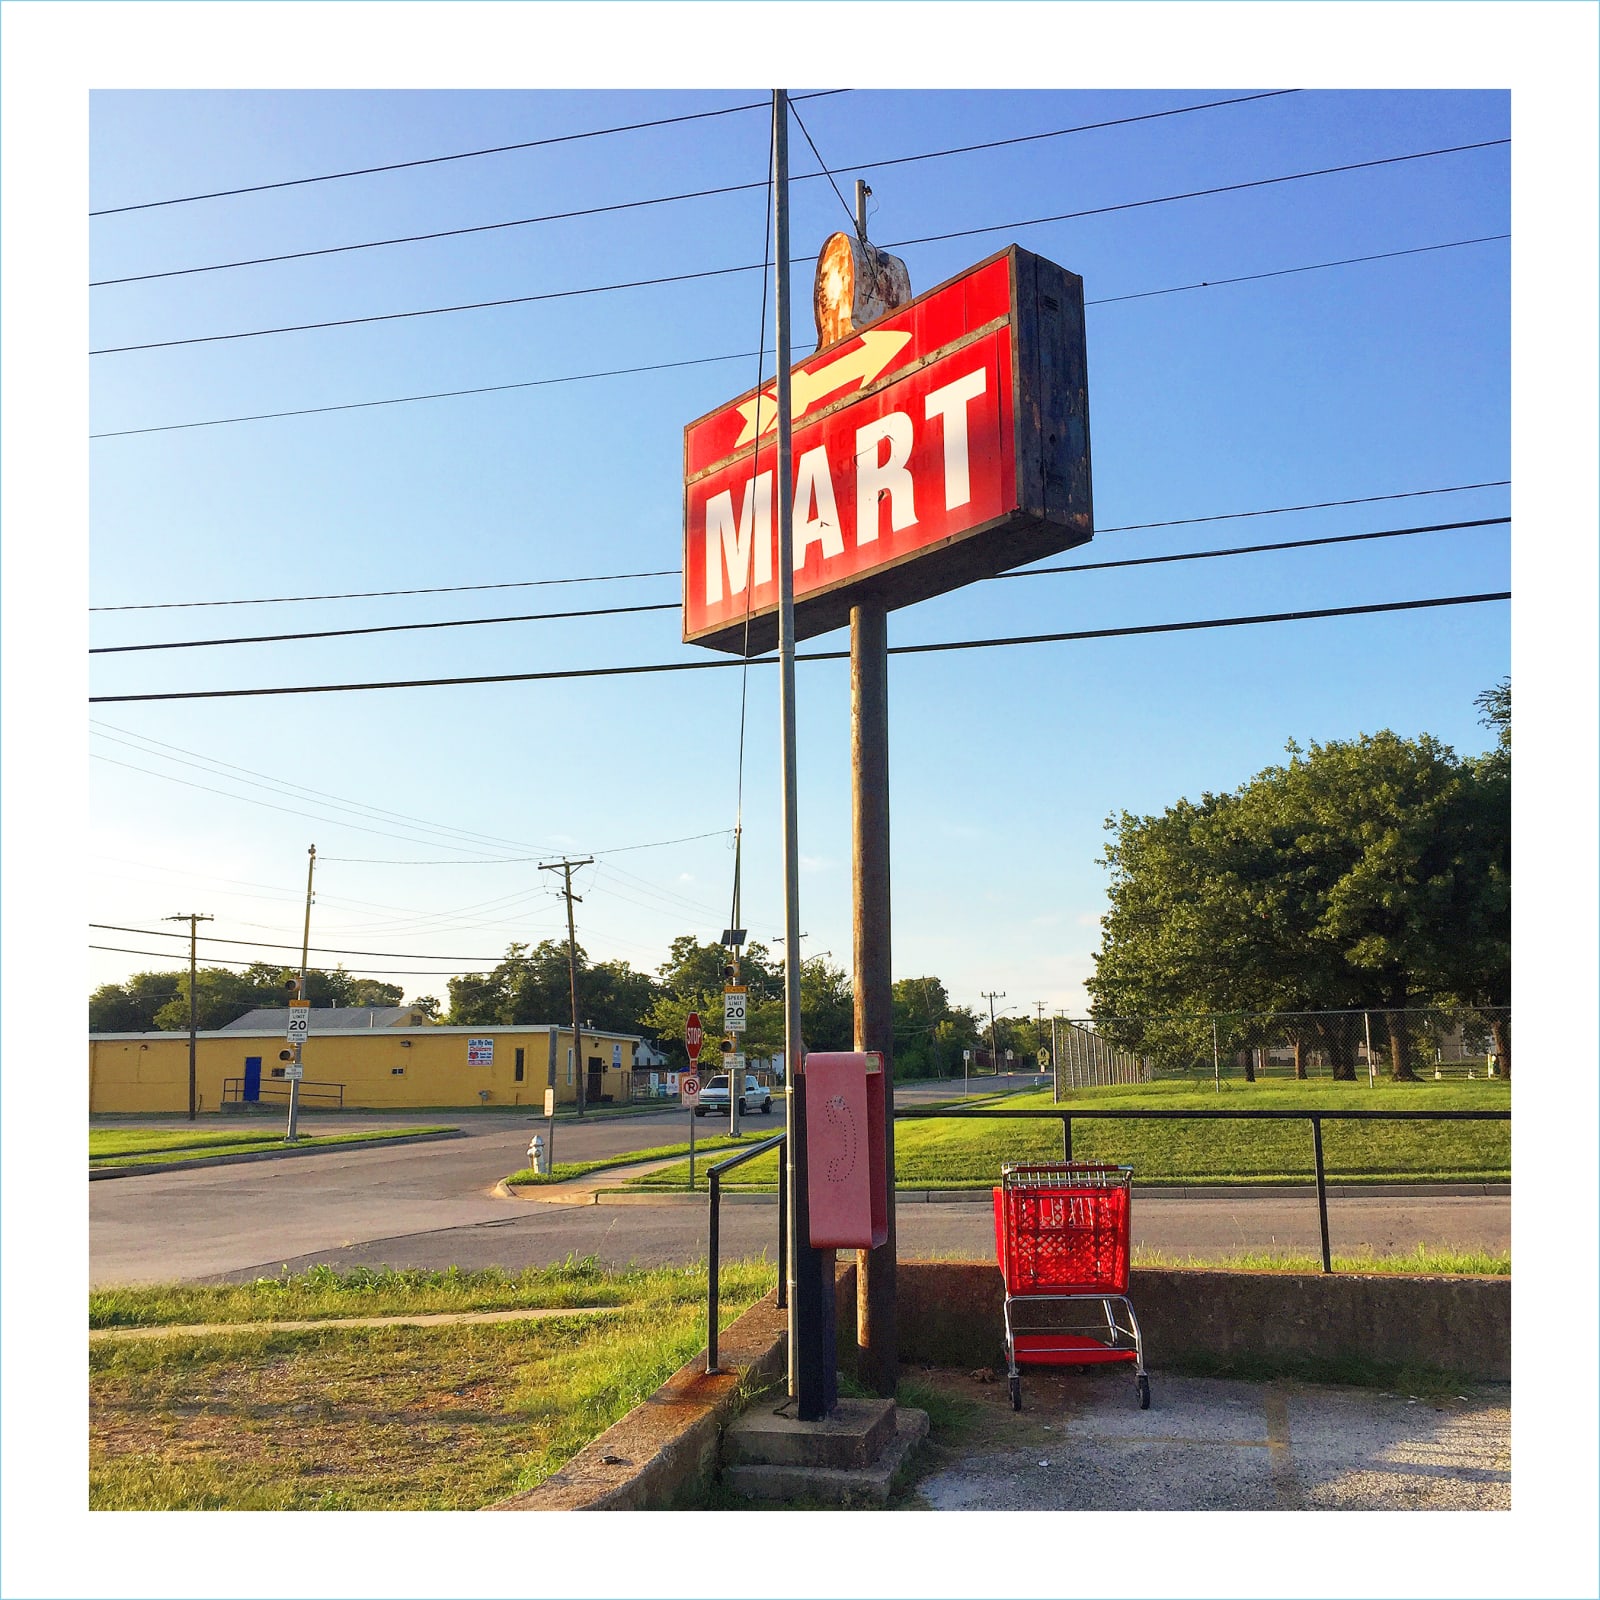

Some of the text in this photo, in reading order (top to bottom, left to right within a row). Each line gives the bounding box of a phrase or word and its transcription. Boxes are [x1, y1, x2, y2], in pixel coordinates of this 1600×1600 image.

[706, 366, 987, 605] MART
[726, 1007, 744, 1018] 20
[289, 1020, 307, 1030] 20
[687, 1027, 701, 1045] STOP
